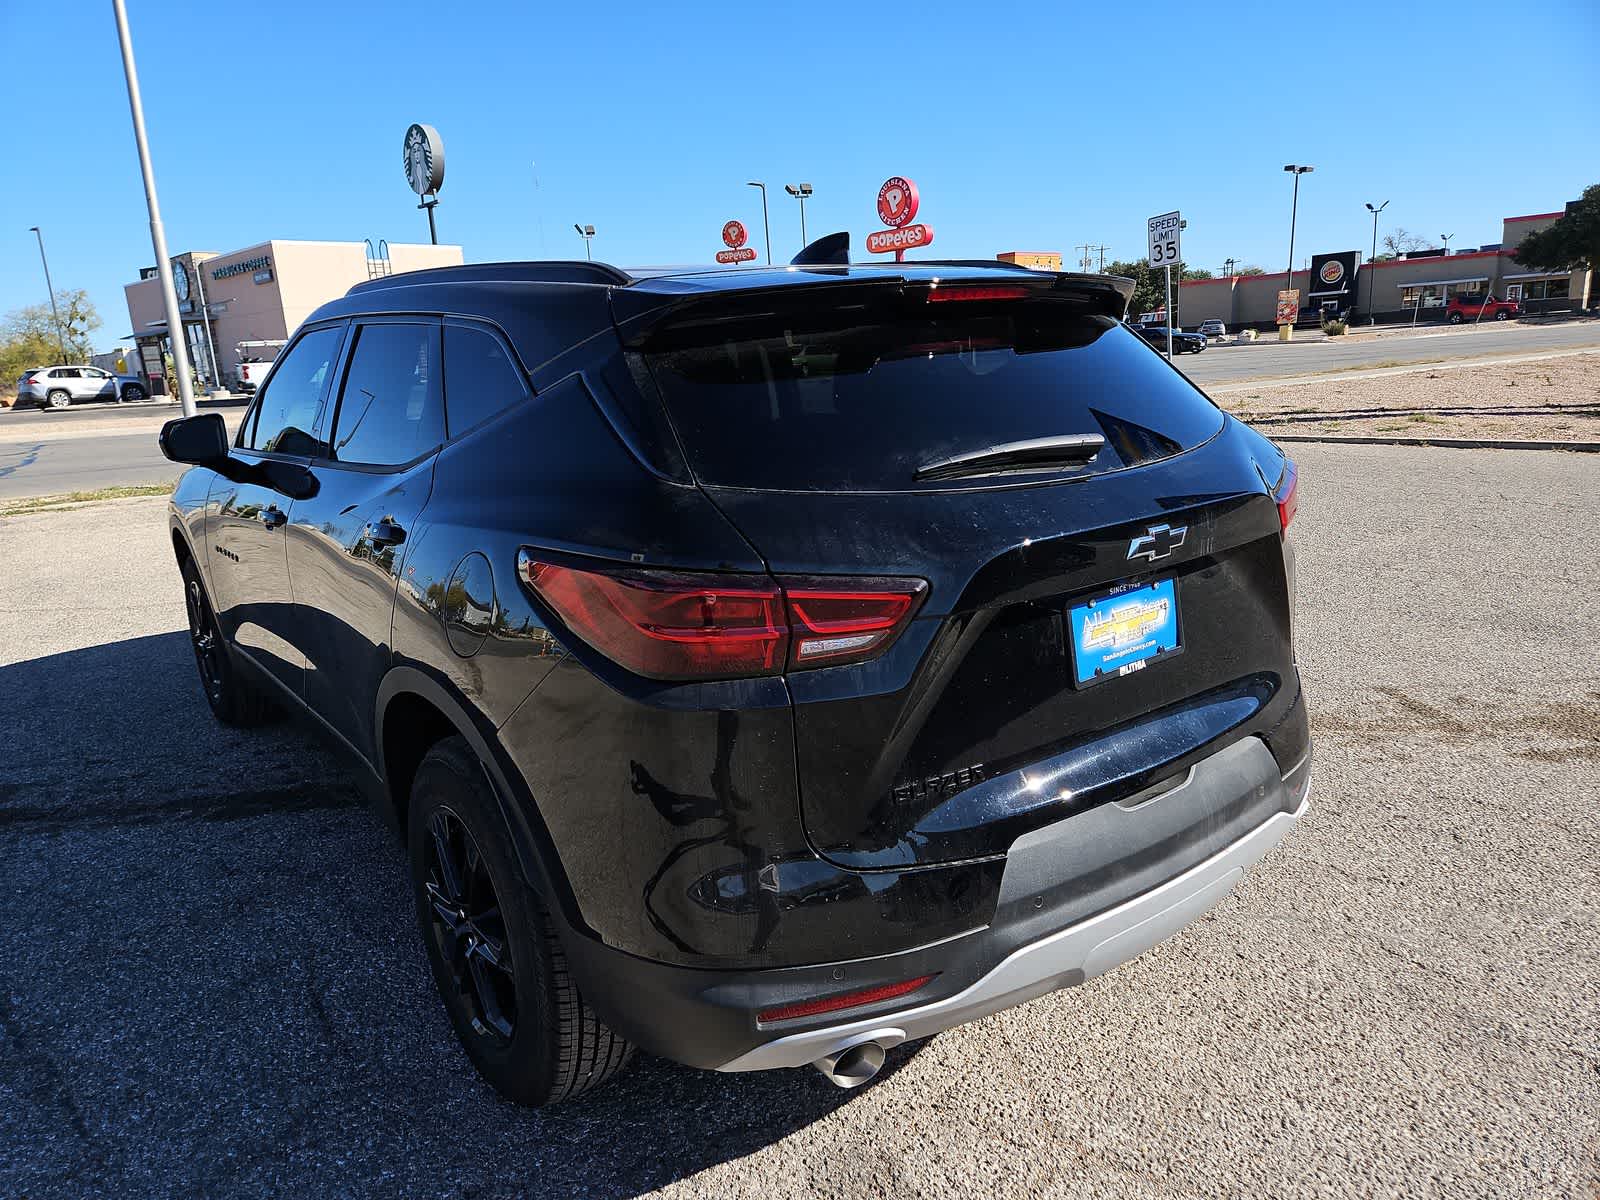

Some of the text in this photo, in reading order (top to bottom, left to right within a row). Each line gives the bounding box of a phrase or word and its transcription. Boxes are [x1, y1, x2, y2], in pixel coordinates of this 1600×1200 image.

[878, 178, 910, 201] LOUISIANA
[885, 188, 902, 214] P
[879, 207, 910, 225] KITCHEN
[1150, 217, 1178, 232] SPEED
[1153, 229, 1175, 243] LIMIT
[1153, 241, 1177, 263] 35
[1109, 584, 1127, 596] SINCE
